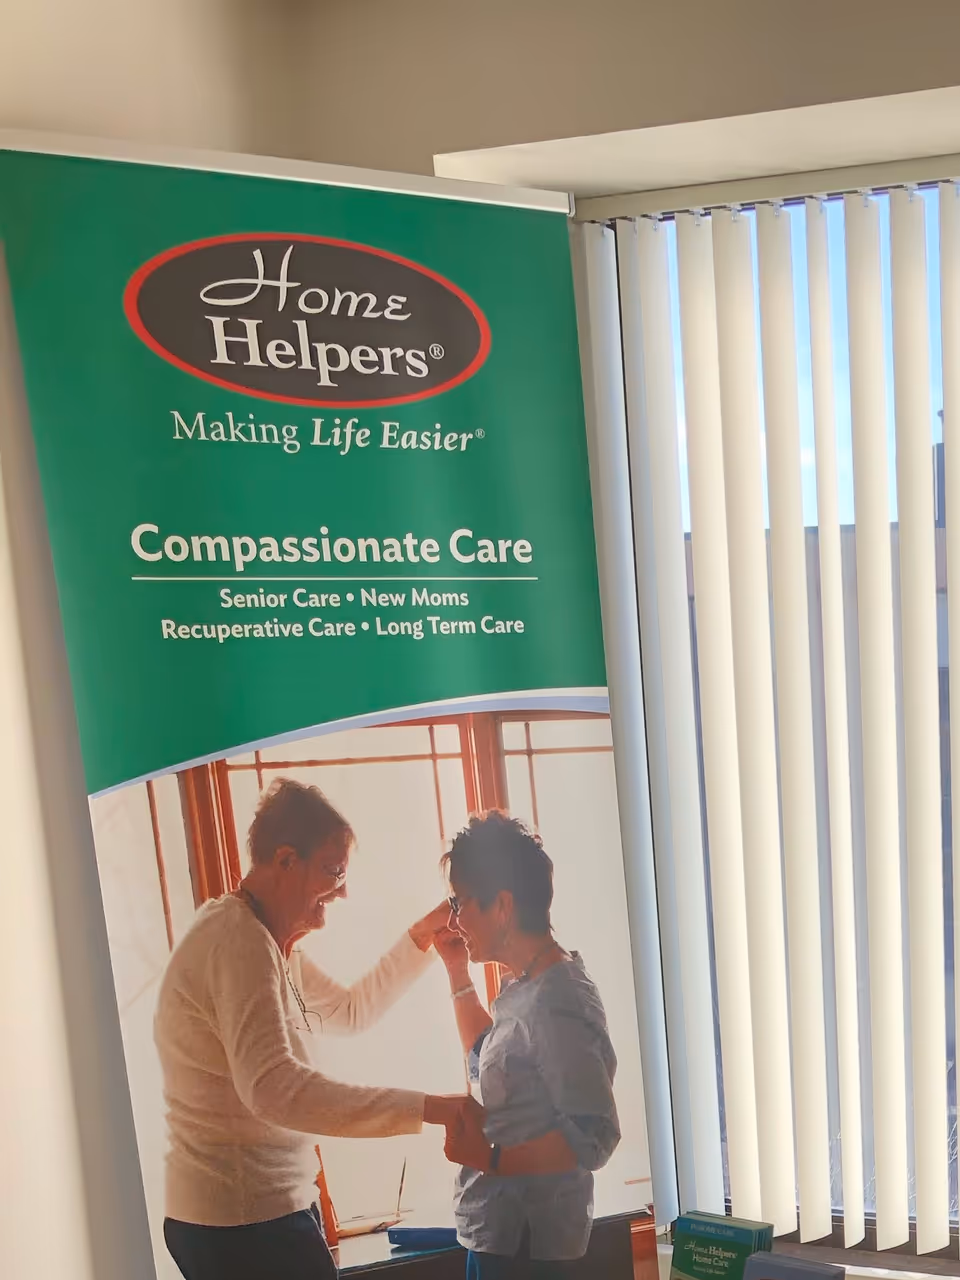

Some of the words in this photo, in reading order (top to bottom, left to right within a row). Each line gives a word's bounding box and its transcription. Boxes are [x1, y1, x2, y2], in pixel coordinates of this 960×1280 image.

[199, 245, 412, 321] Home
[170, 411, 298, 453] Making
[310, 418, 371, 455] Life
[130, 523, 441, 571] Compassionate
[449, 529, 533, 564] Care
[219, 588, 288, 609] Senior
[293, 590, 341, 608] Care
[360, 588, 406, 607] New
[411, 588, 469, 607] Moms
[161, 619, 304, 643] Recuperative
[307, 618, 356, 637] Care
[375, 618, 425, 640] Long
[427, 617, 476, 635] Term
[480, 616, 525, 635] Care
[712, 1257, 729, 1268] Care
